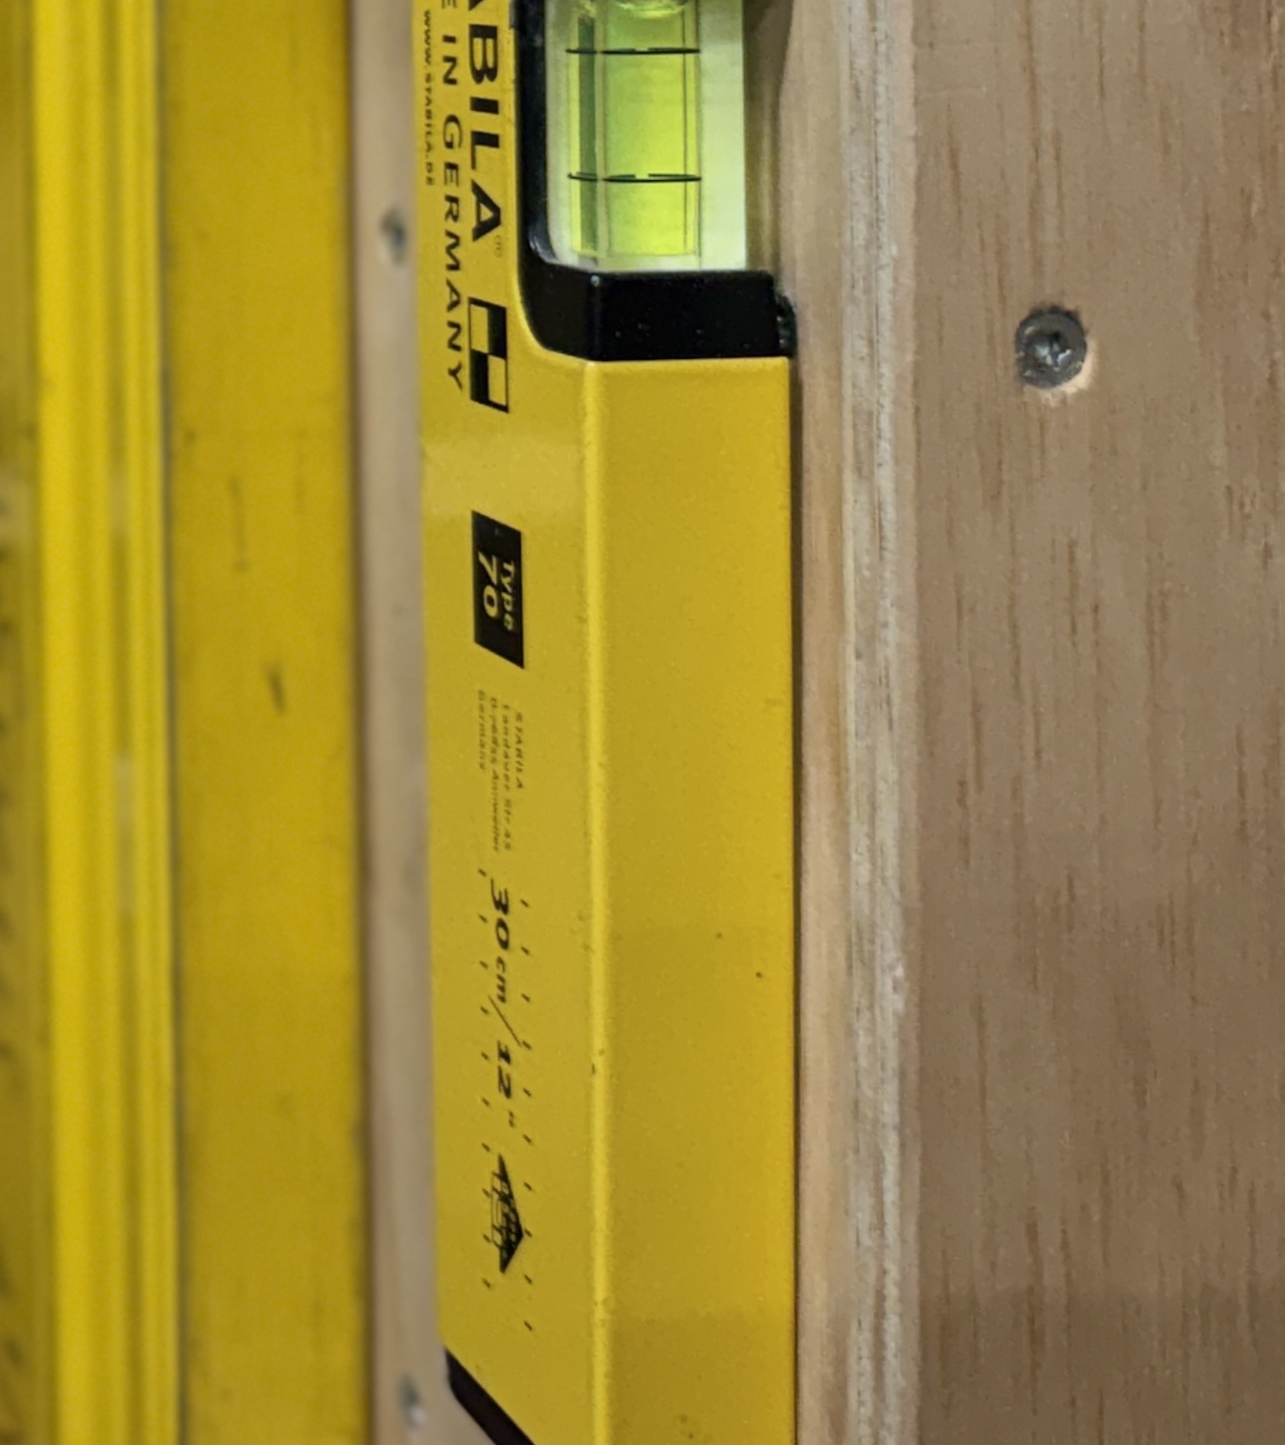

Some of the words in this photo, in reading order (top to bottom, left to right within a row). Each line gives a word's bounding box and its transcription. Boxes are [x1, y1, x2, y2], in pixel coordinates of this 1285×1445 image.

[442, 34, 459, 86] IN
[443, 113, 463, 391] GERMANY
[478, 550, 499, 618] 70
[500, 559, 515, 631] Type
